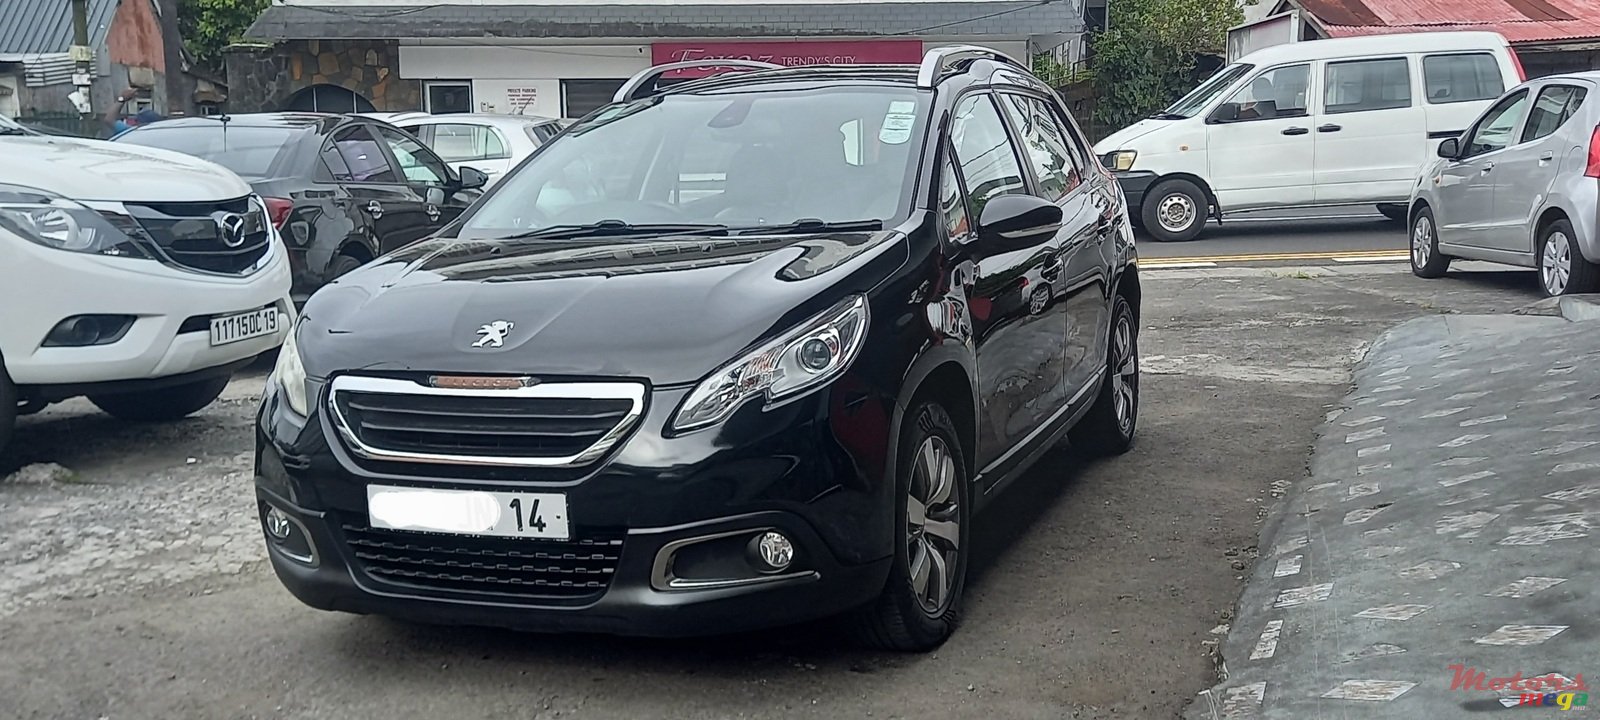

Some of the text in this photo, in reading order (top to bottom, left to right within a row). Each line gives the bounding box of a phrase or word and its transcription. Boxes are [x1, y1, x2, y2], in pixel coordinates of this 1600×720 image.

[781, 56, 830, 66] TRENDY'S
[832, 56, 856, 65] CITY
[264, 310, 276, 331] 19
[509, 498, 547, 532] 14
